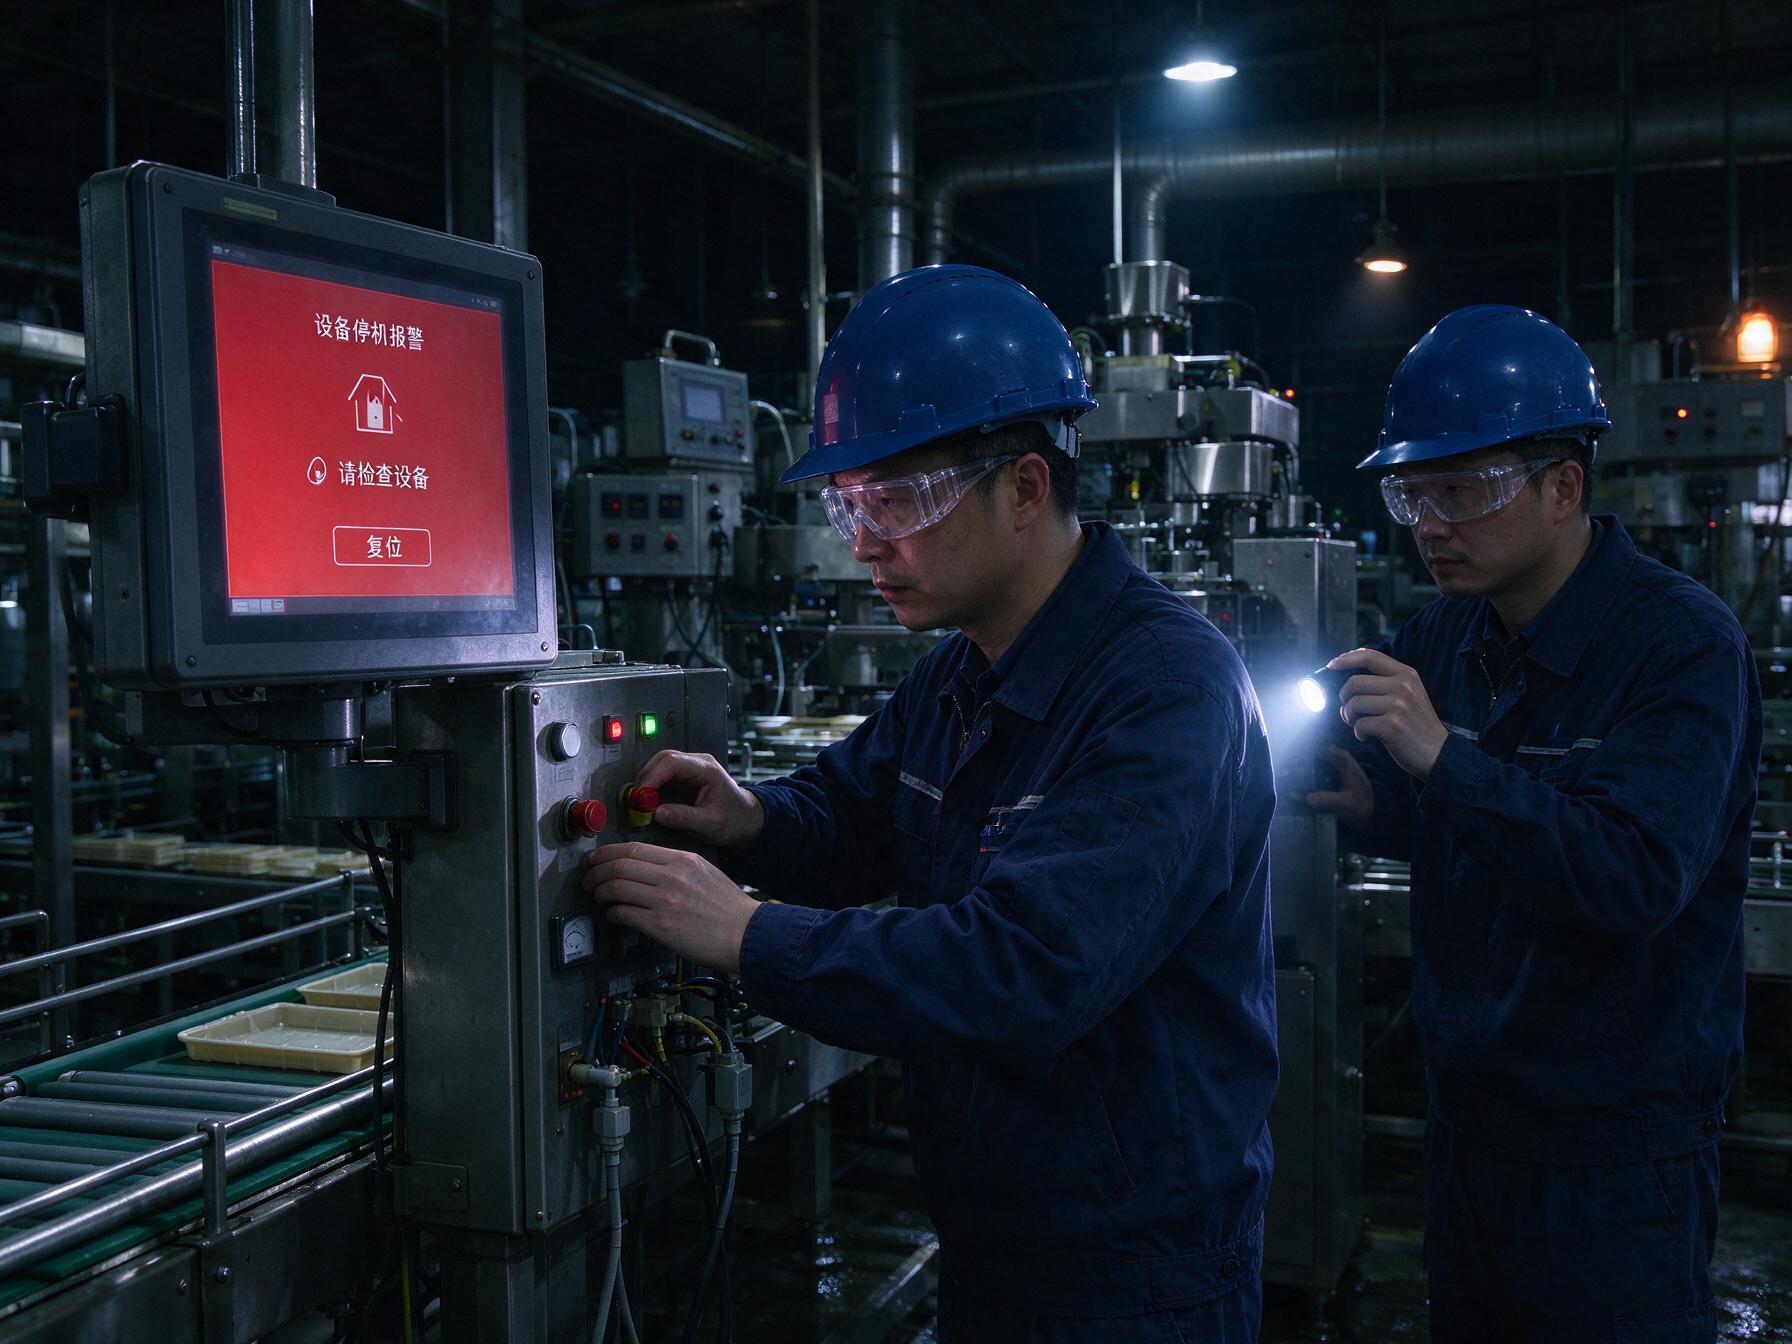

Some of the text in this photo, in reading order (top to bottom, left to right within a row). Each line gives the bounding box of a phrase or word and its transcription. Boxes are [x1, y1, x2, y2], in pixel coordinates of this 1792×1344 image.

[314, 312, 425, 351] 设备停机报警
[338, 460, 430, 490] 请检查设备
[366, 534, 403, 559] 复位
